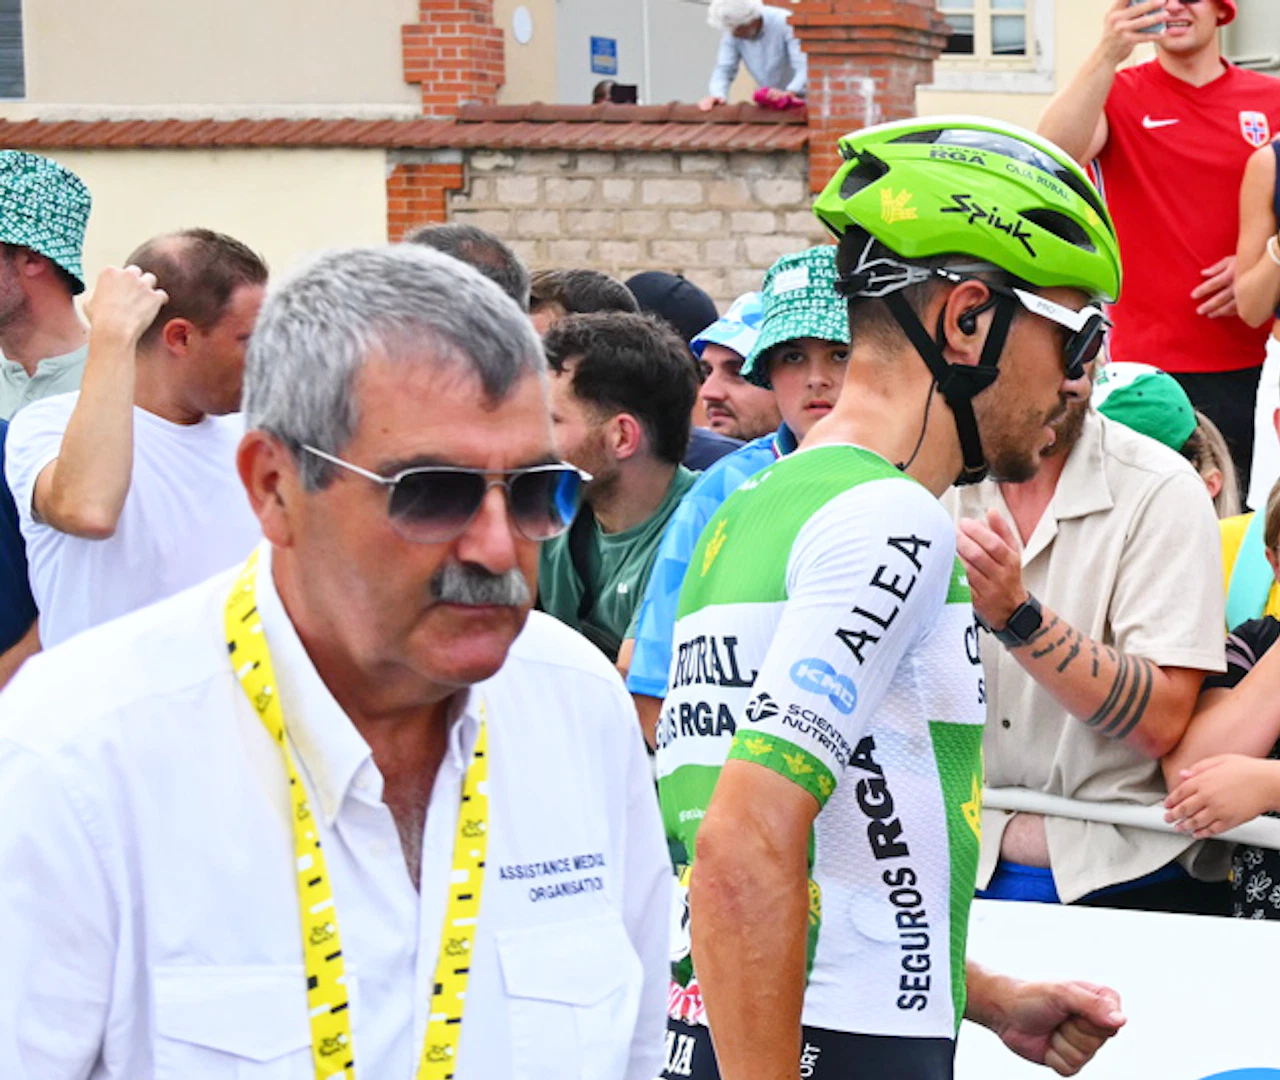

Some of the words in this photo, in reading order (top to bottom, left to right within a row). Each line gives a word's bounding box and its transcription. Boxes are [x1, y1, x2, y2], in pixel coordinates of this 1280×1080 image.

[1037, 175, 1070, 201] RURAL
[940, 194, 1036, 257] Spiuk
[835, 533, 931, 664] ALEA
[796, 664, 855, 709] KMC
[680, 702, 736, 737] RGA
[845, 736, 910, 861] RGA
[499, 858, 571, 881] ASSISTANCE
[884, 868, 931, 1011] SEGUROS
[665, 1029, 696, 1076] AJA
